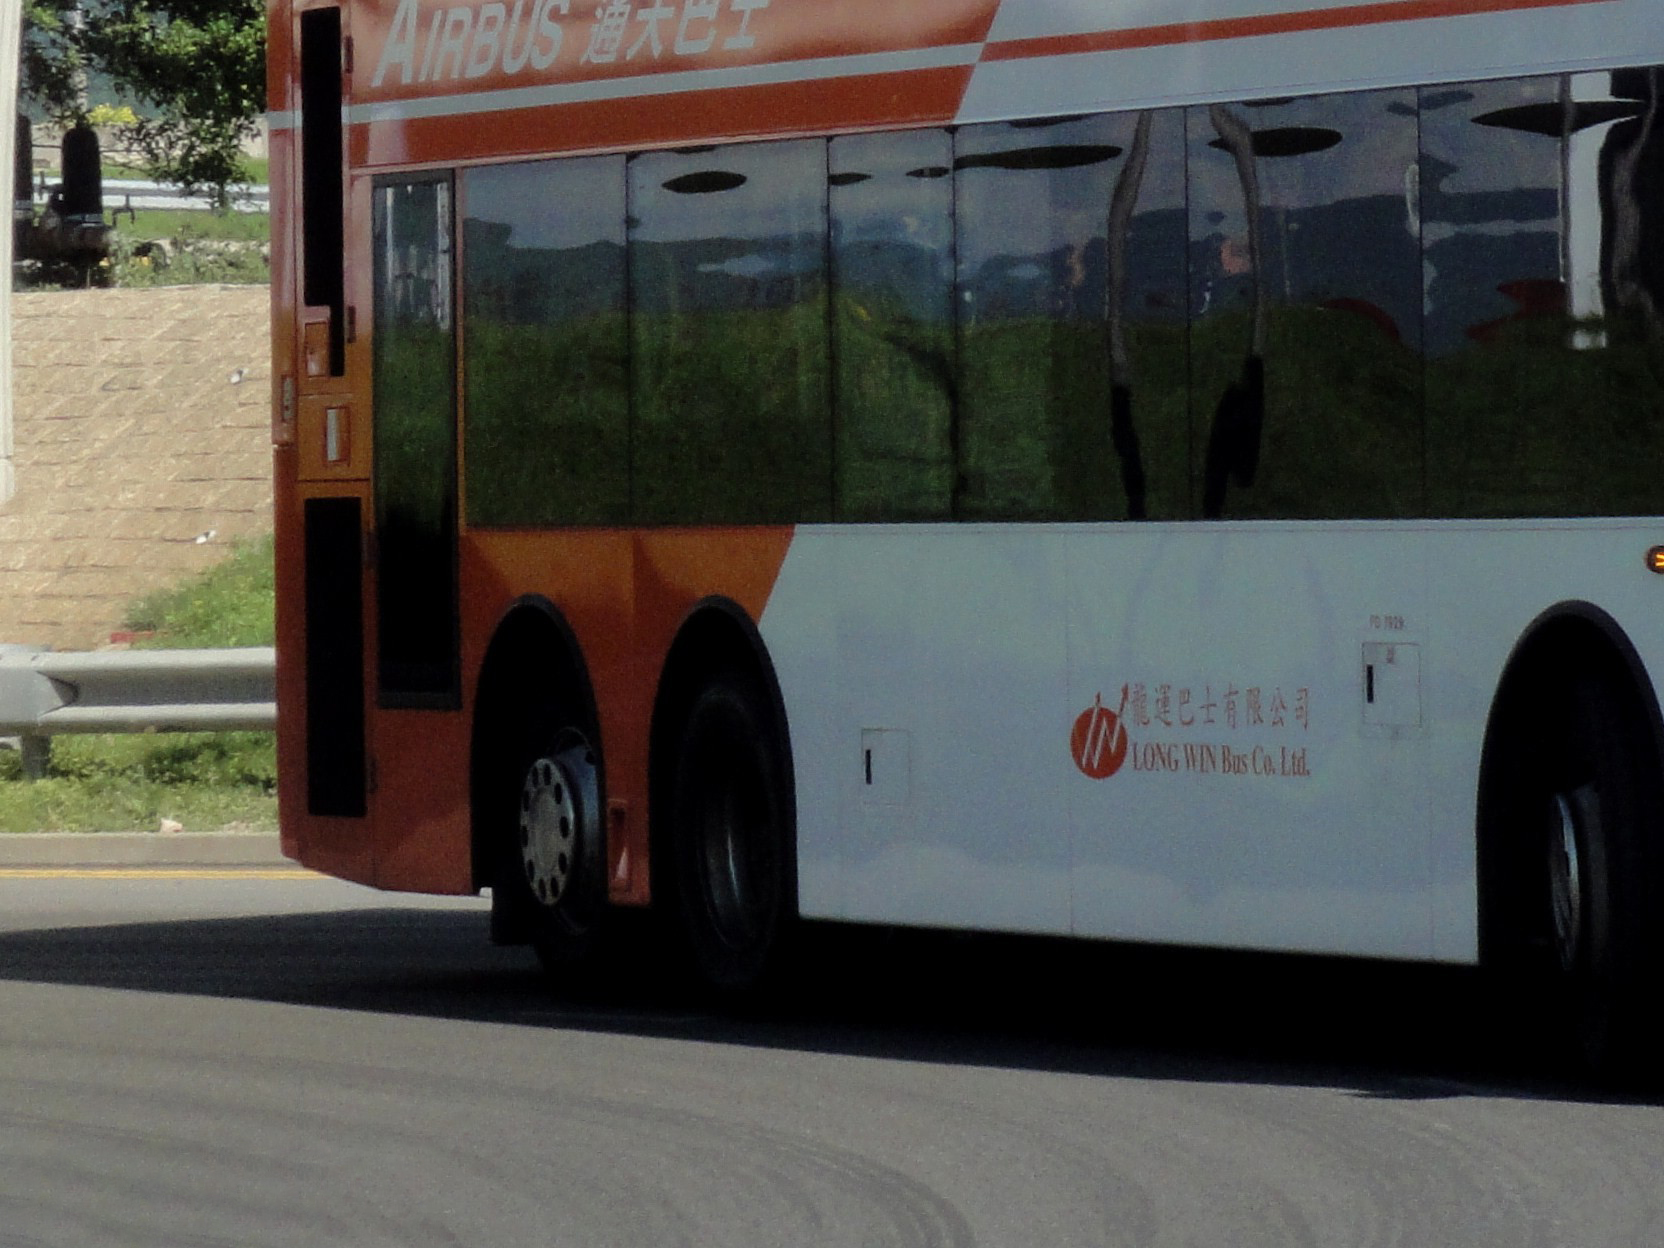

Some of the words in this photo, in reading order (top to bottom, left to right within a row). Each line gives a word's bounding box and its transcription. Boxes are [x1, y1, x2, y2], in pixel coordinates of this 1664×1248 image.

[1132, 682, 1310, 732] 龍運巴士有限公司
[1132, 741, 1180, 773] LONG
[1183, 742, 1217, 774] WIN
[1221, 743, 1249, 775] Bus
[1251, 744, 1277, 776] Co.
[1279, 745, 1311, 777] Ltd.
